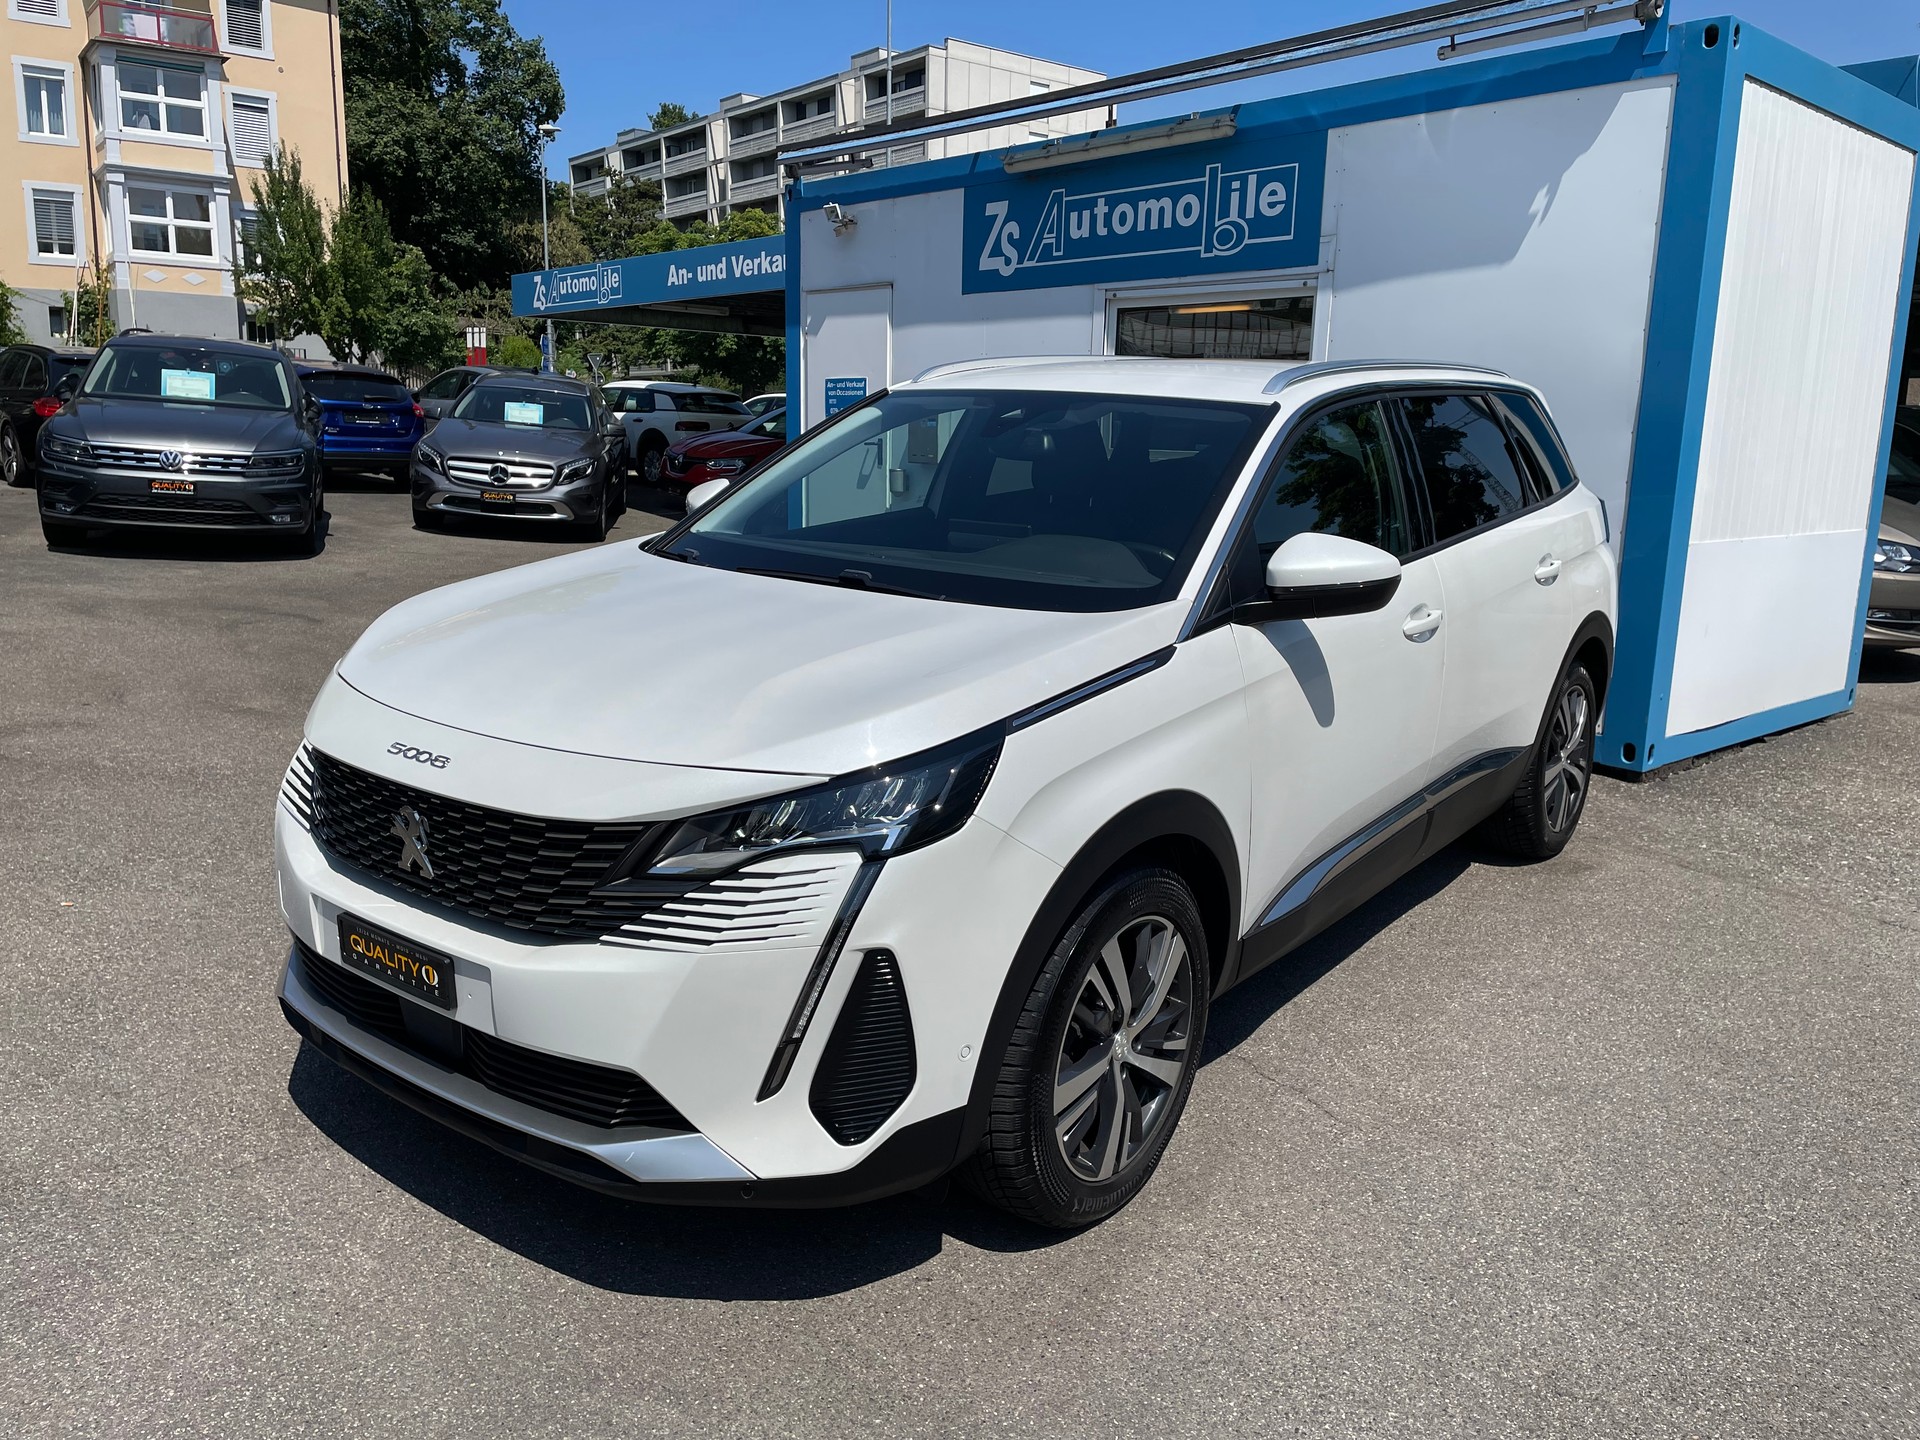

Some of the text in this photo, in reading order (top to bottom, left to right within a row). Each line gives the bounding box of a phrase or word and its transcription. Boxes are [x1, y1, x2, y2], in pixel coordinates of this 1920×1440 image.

[1023, 162, 1287, 266] Automobile
[547, 263, 620, 306] Automobile
[667, 251, 786, 286] An- und Verka
[846, 380, 865, 388] Verkauf
[387, 741, 452, 769] 5008
[352, 953, 440, 997] GARANTIE
